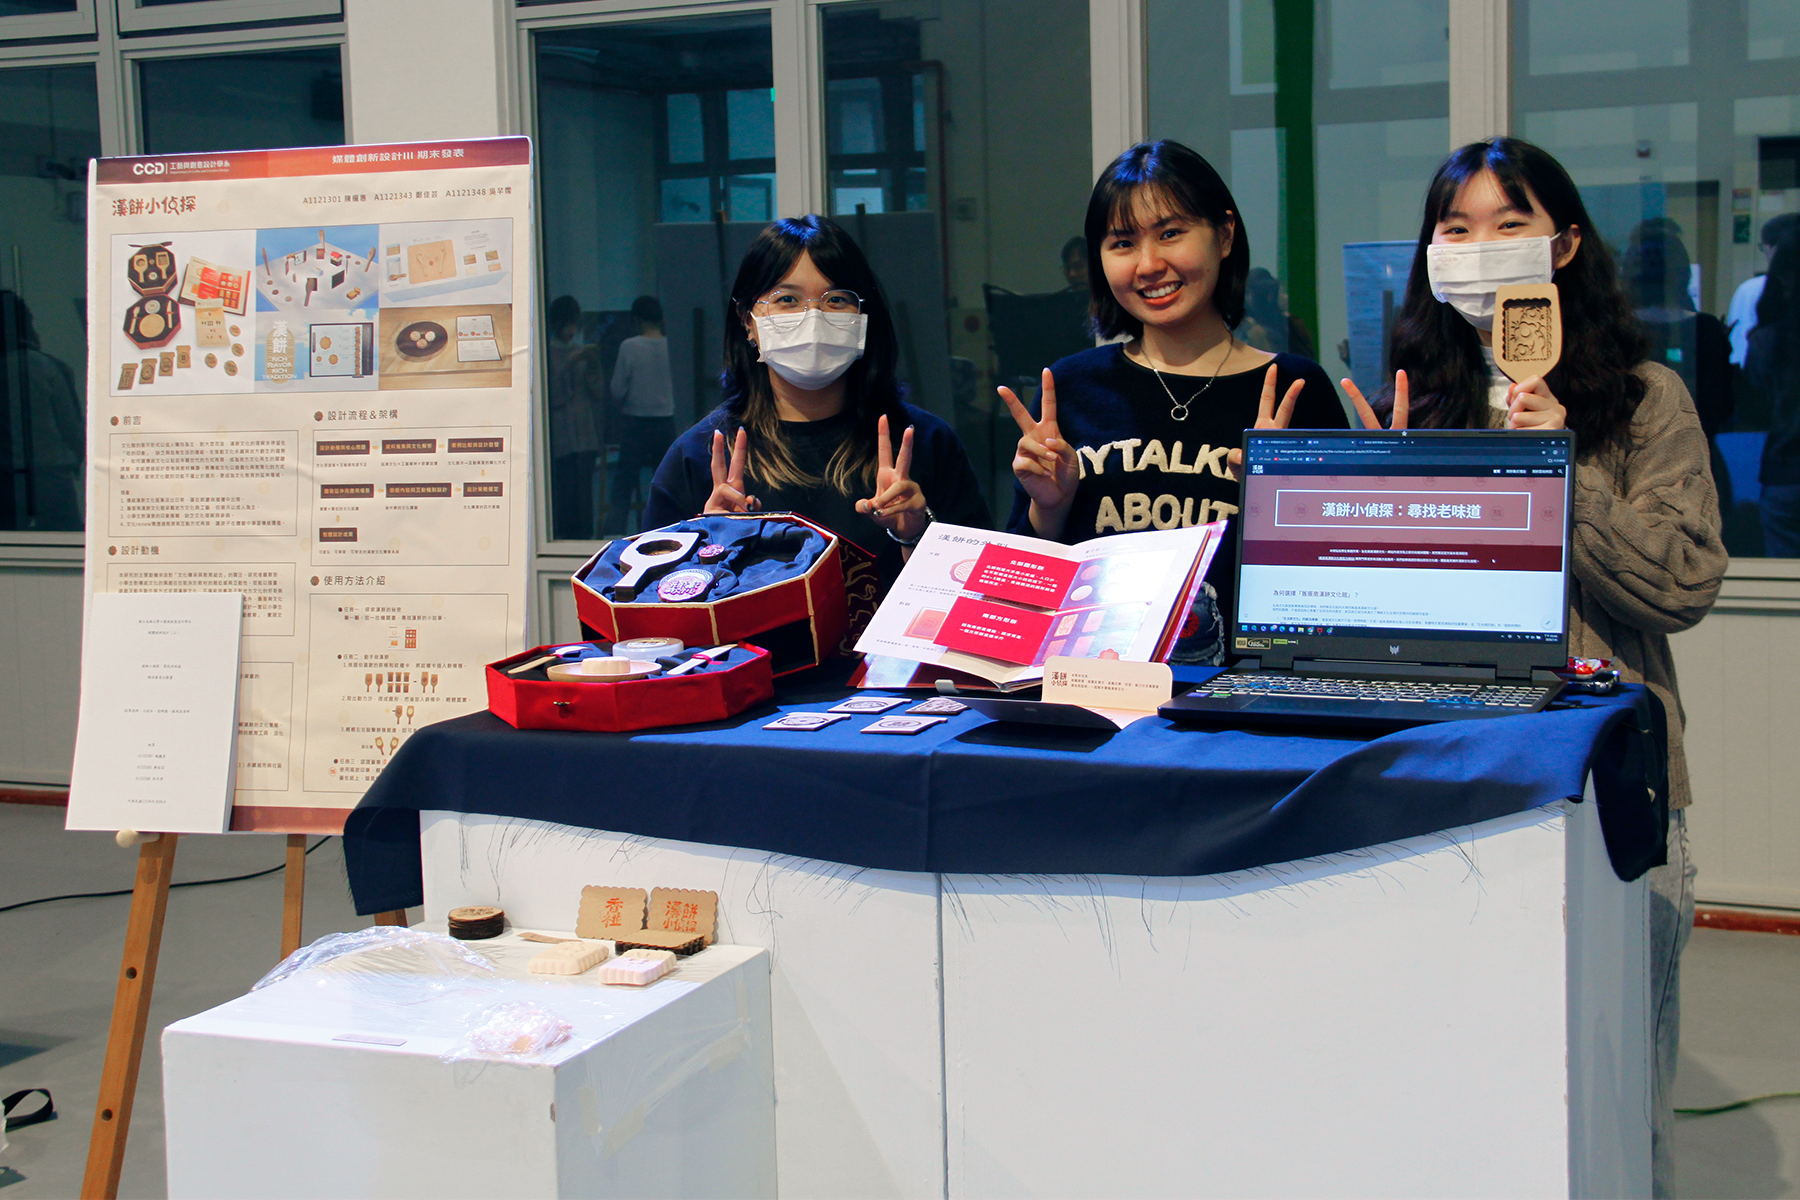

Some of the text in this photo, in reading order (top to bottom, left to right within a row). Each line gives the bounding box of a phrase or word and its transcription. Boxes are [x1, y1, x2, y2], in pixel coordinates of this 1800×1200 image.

[332, 148, 465, 164] 媒體創新設計III 期末發表
[133, 163, 165, 175] CCD
[303, 196, 342, 204] A1121301
[374, 192, 412, 200] A1121343
[446, 188, 486, 197] A1121348
[112, 196, 196, 216] 漢餅小偵探
[122, 415, 142, 426] 前言
[1096, 492, 1239, 534] ABOUT
[1322, 502, 1482, 519] 漢餅小偵探：尋找老味道
[121, 545, 160, 556] 設計動機
[324, 576, 386, 586] 使用方法介紹
